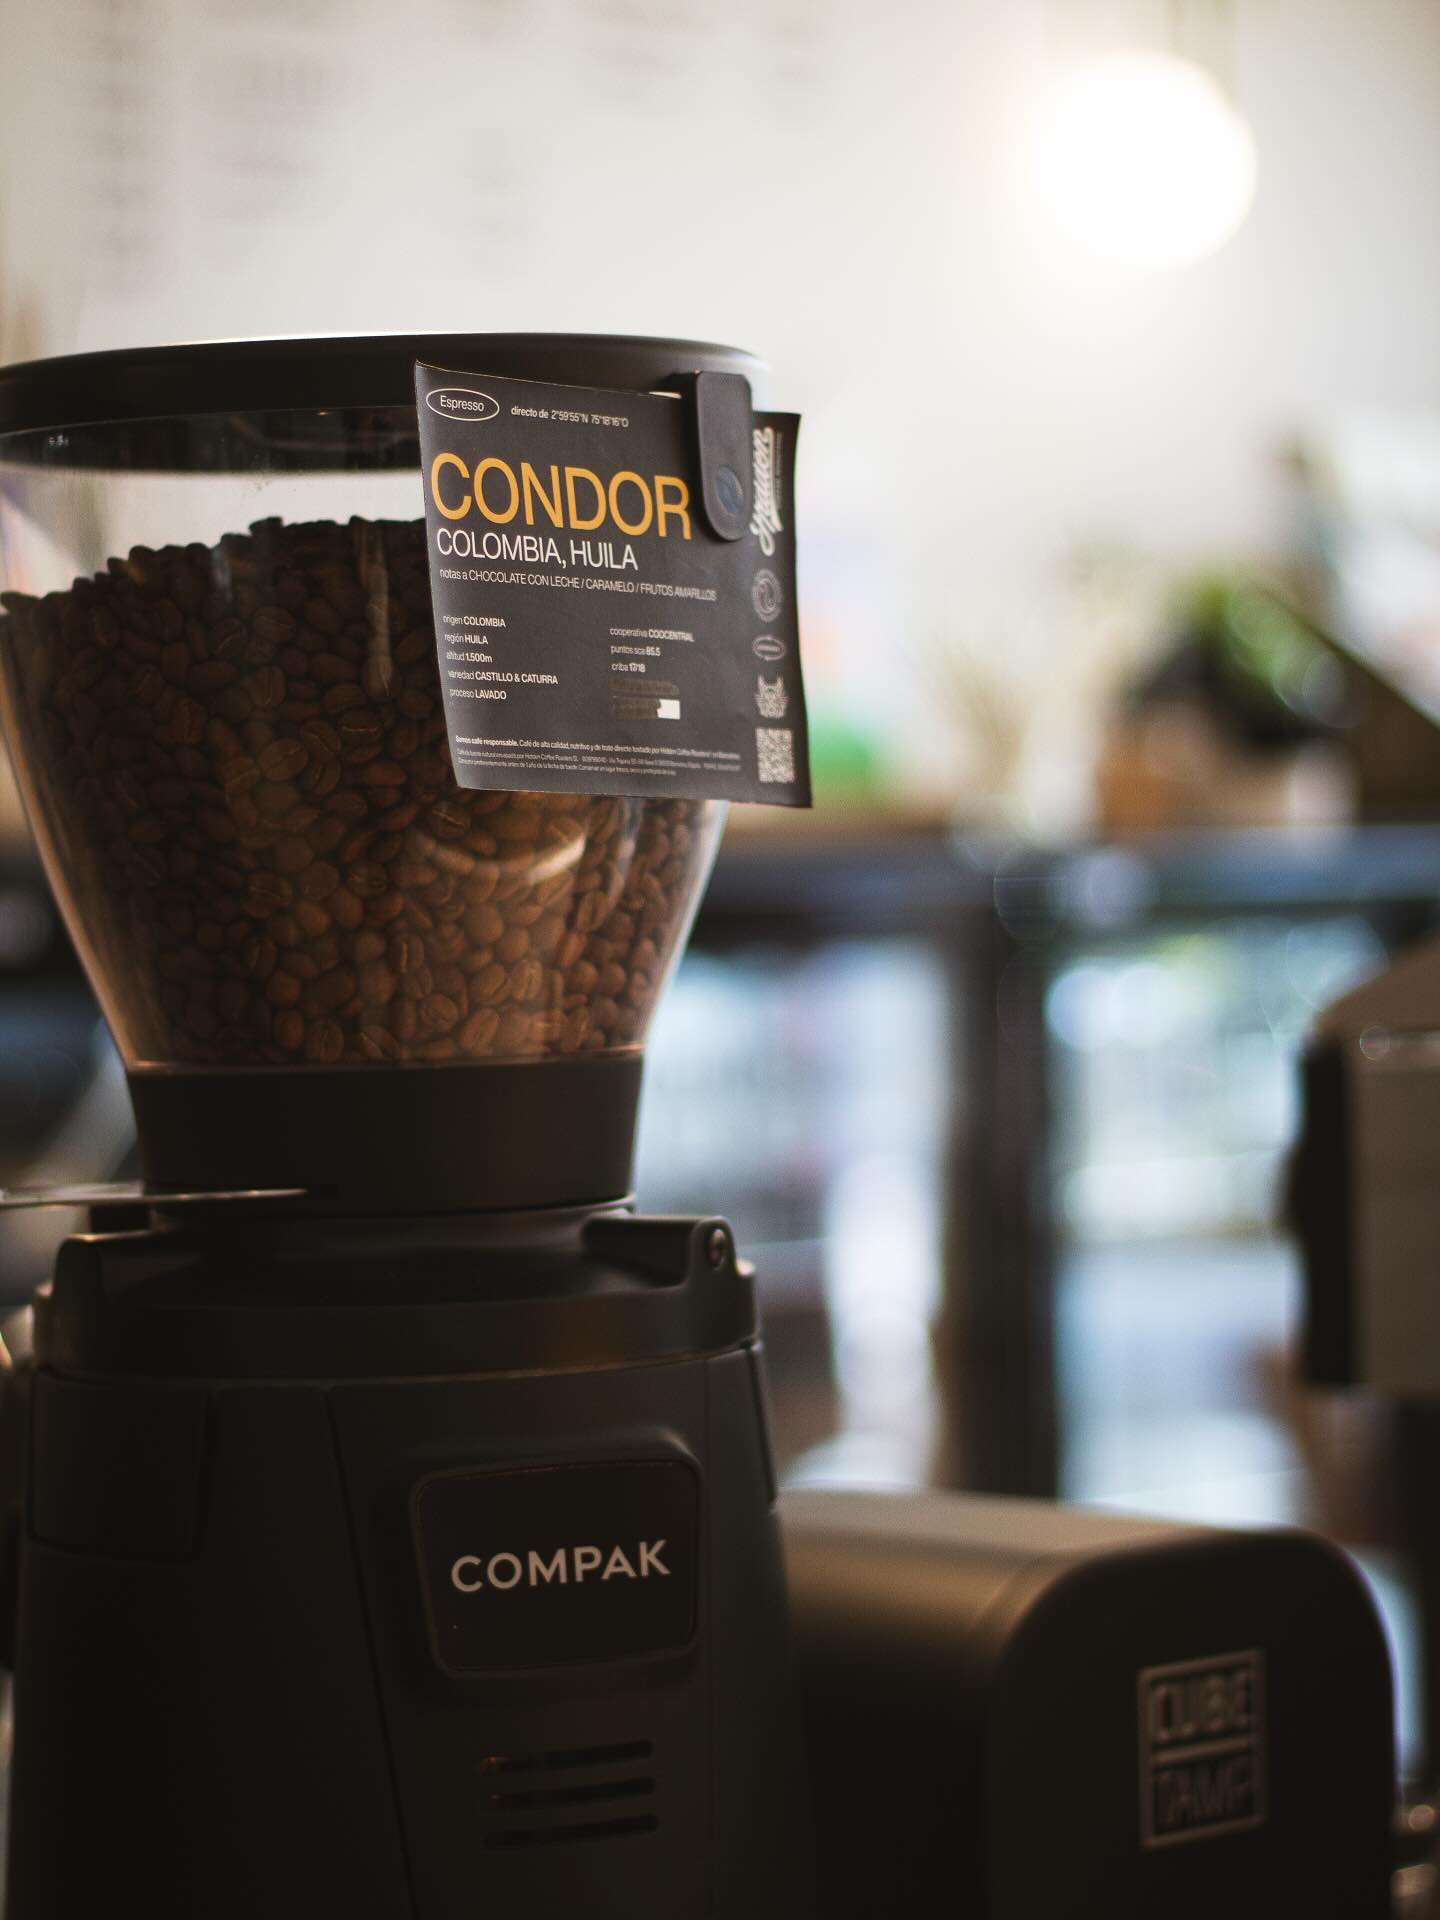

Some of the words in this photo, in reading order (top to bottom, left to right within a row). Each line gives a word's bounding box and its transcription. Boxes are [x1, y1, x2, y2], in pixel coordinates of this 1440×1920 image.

[439, 395, 485, 413] Espresso
[510, 405, 538, 418] directo
[538, 408, 549, 419] de
[431, 452, 692, 540] CONDOR
[437, 528, 567, 569] COLOMBIA,
[569, 539, 639, 571] HUILA
[439, 568, 461, 580] notas
[462, 571, 468, 580] a
[468, 569, 527, 585] CHOCOLATE
[527, 574, 550, 587] CON
[550, 576, 580, 589] LECHE
[580, 578, 585, 589] /
[585, 578, 634, 593] CARAMELO
[635, 582, 640, 593] /
[640, 583, 674, 597] FRUTOS
[674, 586, 717, 601] AMARILLOS
[443, 615, 463, 626] origen
[463, 615, 507, 628] COLOMBIA
[444, 632, 464, 644] región
[464, 634, 489, 645] HUILA
[609, 628, 648, 639] cooperativa
[648, 628, 695, 642] COOCENTRAL
[446, 651, 465, 661] altitud
[465, 652, 493, 663] 1.500m
[610, 645, 633, 655] puntos
[611, 662, 628, 672] criba
[448, 669, 475, 680] variedad
[475, 671, 513, 682] CASTILLO
[514, 674, 521, 683] &
[521, 673, 559, 685] CATURRA
[449, 688, 475, 700] proceso
[475, 689, 507, 700] LAVADO
[519, 738, 532, 747] Café
[532, 740, 540, 748] de
[540, 740, 550, 749] alta
[450, 1539, 671, 1592] COMPAK
